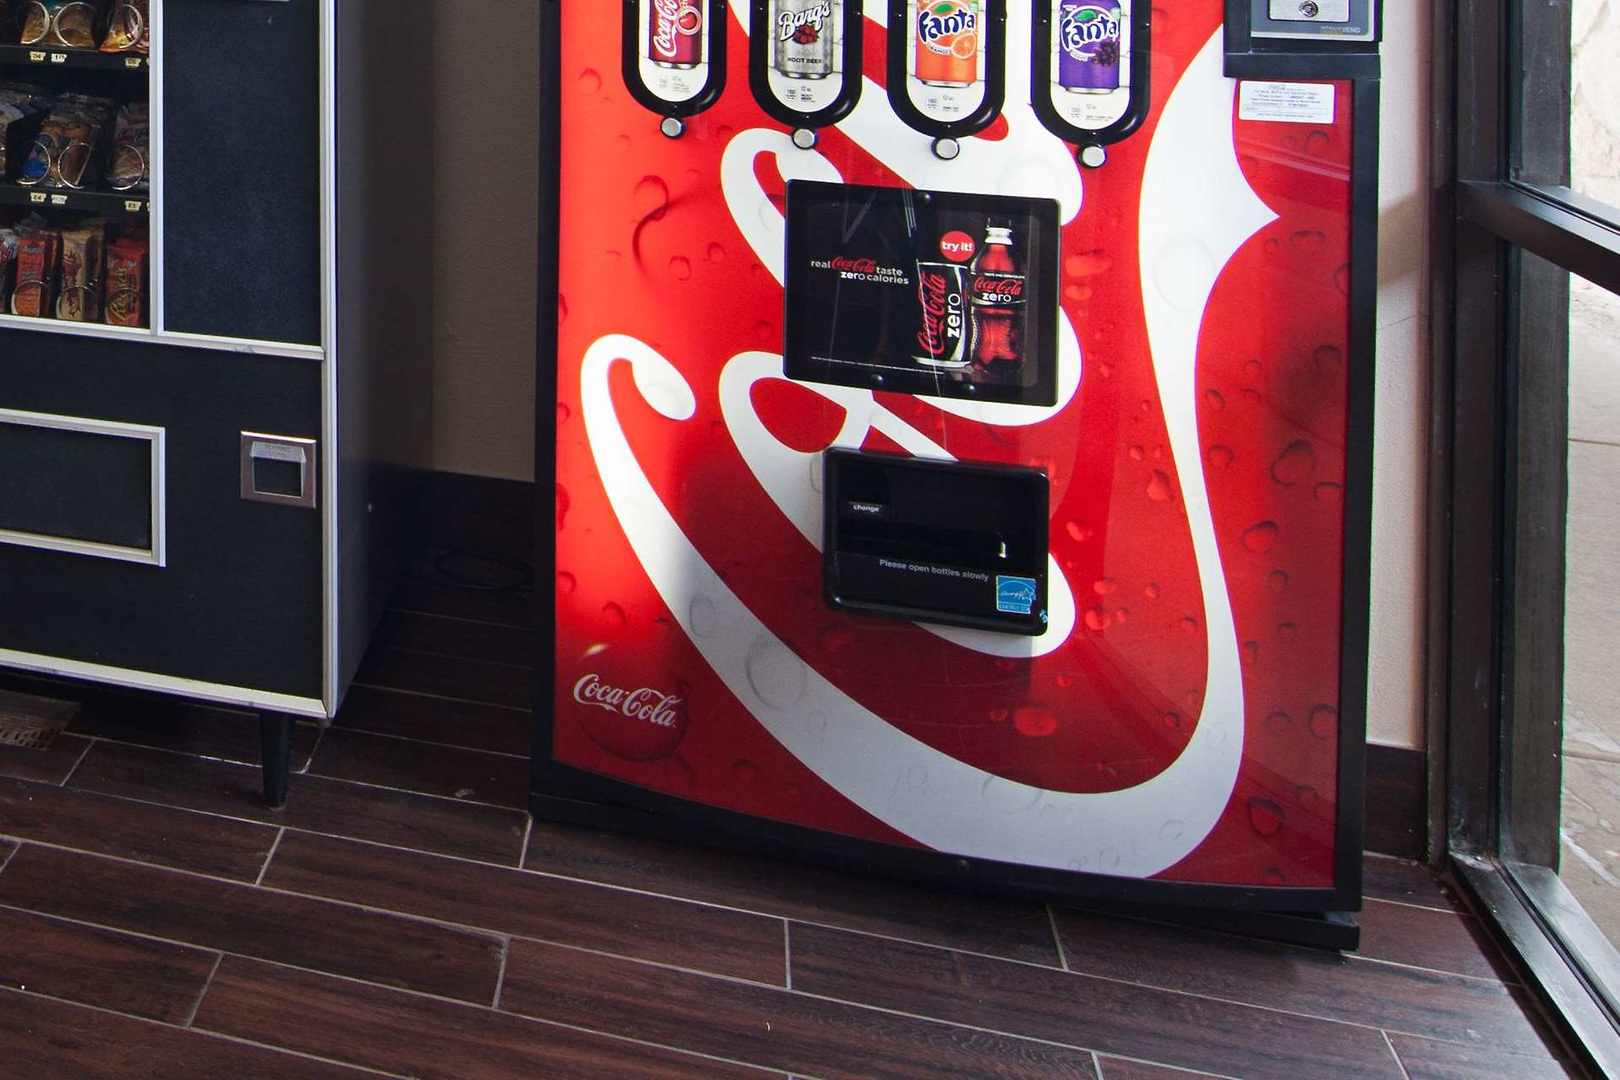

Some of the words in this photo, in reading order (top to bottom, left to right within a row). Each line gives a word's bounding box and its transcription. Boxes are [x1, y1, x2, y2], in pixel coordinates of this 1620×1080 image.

[778, 0, 831, 42] Barq's
[942, 241, 961, 252] try
[960, 242, 973, 252] it!
[810, 259, 831, 269] real
[830, 255, 877, 274] Coca-Cola
[875, 265, 903, 277] taste
[840, 271, 866, 280] zero
[866, 273, 909, 285] calories
[973, 276, 1023, 296] Coca-Cola
[982, 291, 1012, 303] zero
[916, 271, 946, 355] Coca-Cola
[947, 293, 961, 339] zero
[852, 503, 880, 513] change
[879, 558, 907, 570] Please
[908, 564, 930, 573] open
[931, 565, 961, 577] bottles
[961, 571, 990, 582] slowly
[572, 673, 684, 729] Coca-Cola
